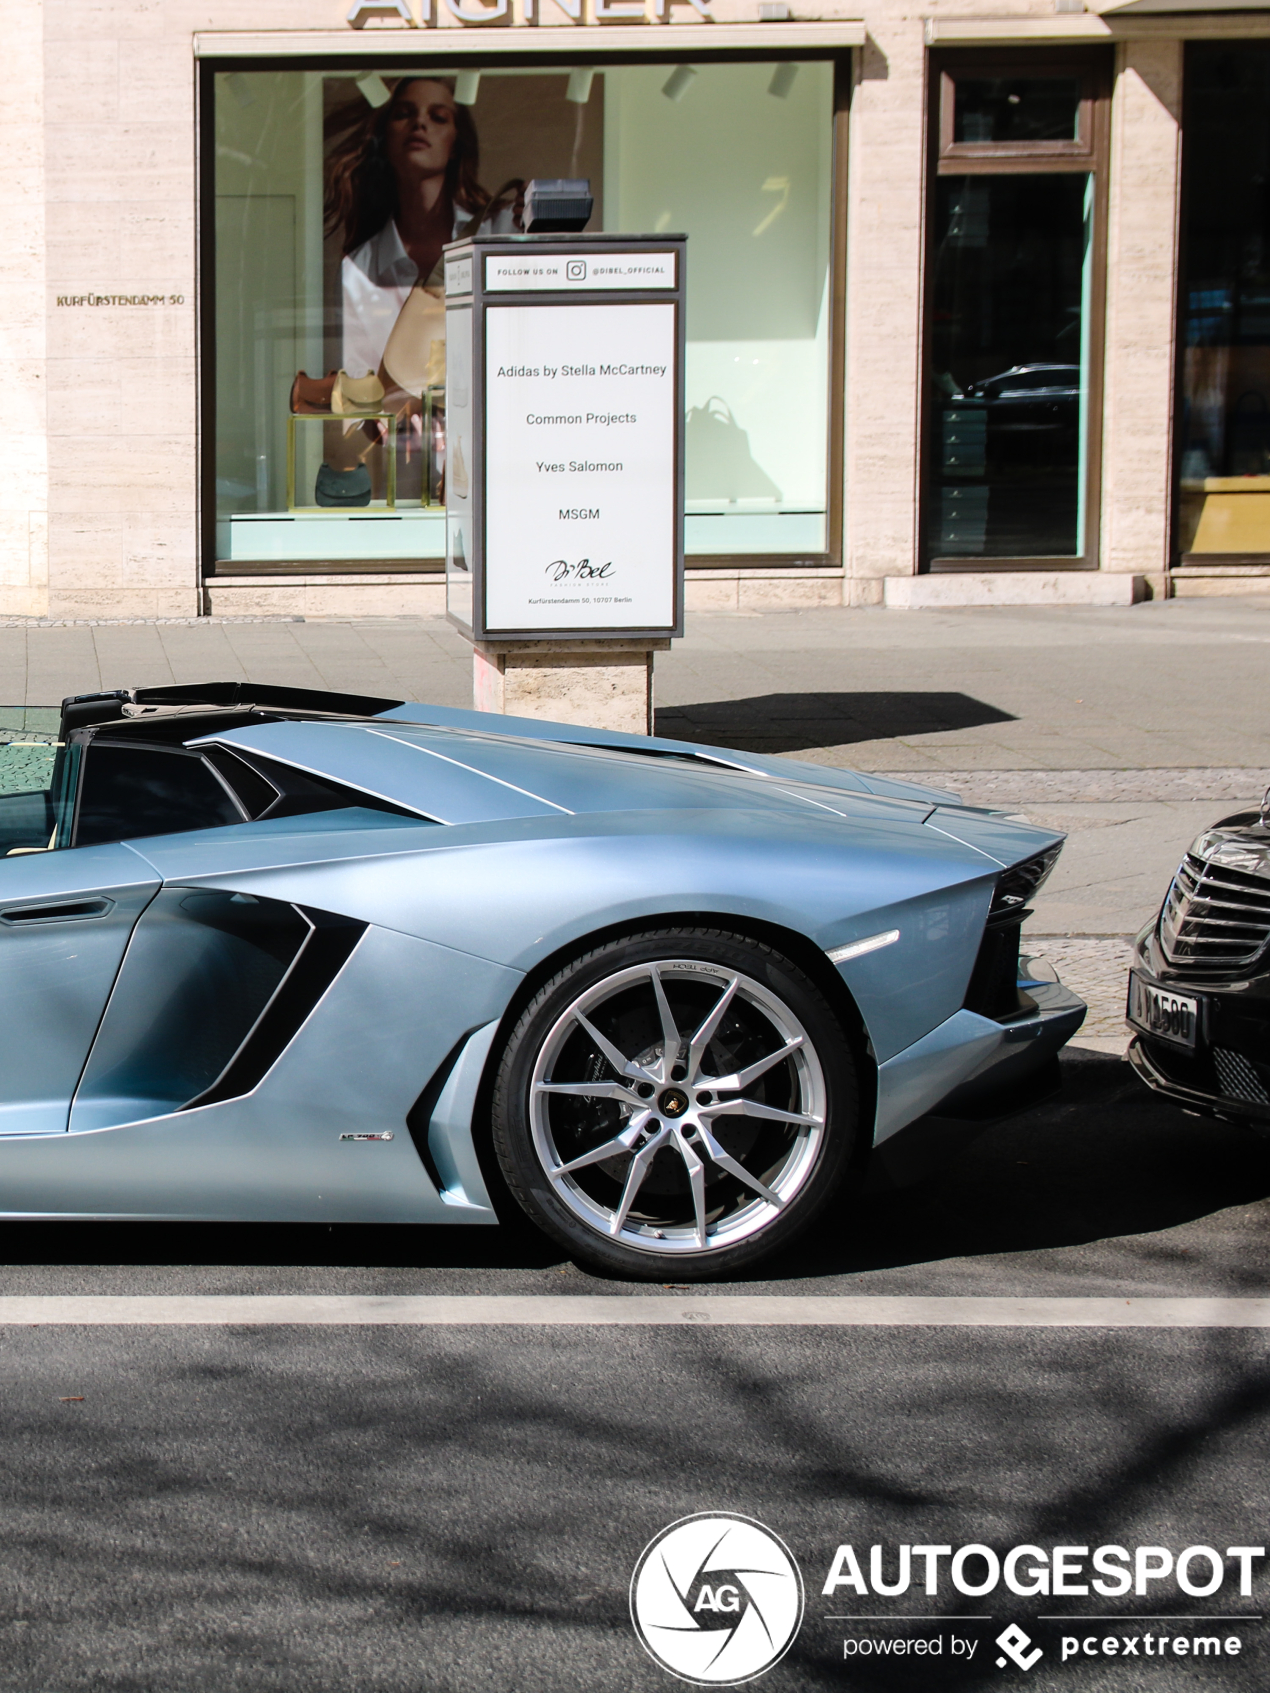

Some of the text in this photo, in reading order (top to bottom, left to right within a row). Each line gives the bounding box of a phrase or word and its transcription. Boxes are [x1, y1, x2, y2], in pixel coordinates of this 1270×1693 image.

[592, 267, 665, 276] @DIBEL_OFFICIAL
[56, 293, 185, 306] KURFÜRSTENDAMM 50
[497, 364, 667, 379] Adidas by Stella McCartney
[526, 413, 637, 426] Common Projects
[536, 460, 623, 472] Yves Salomon
[558, 508, 600, 520] MSGM
[581, 597, 591, 605] 50,
